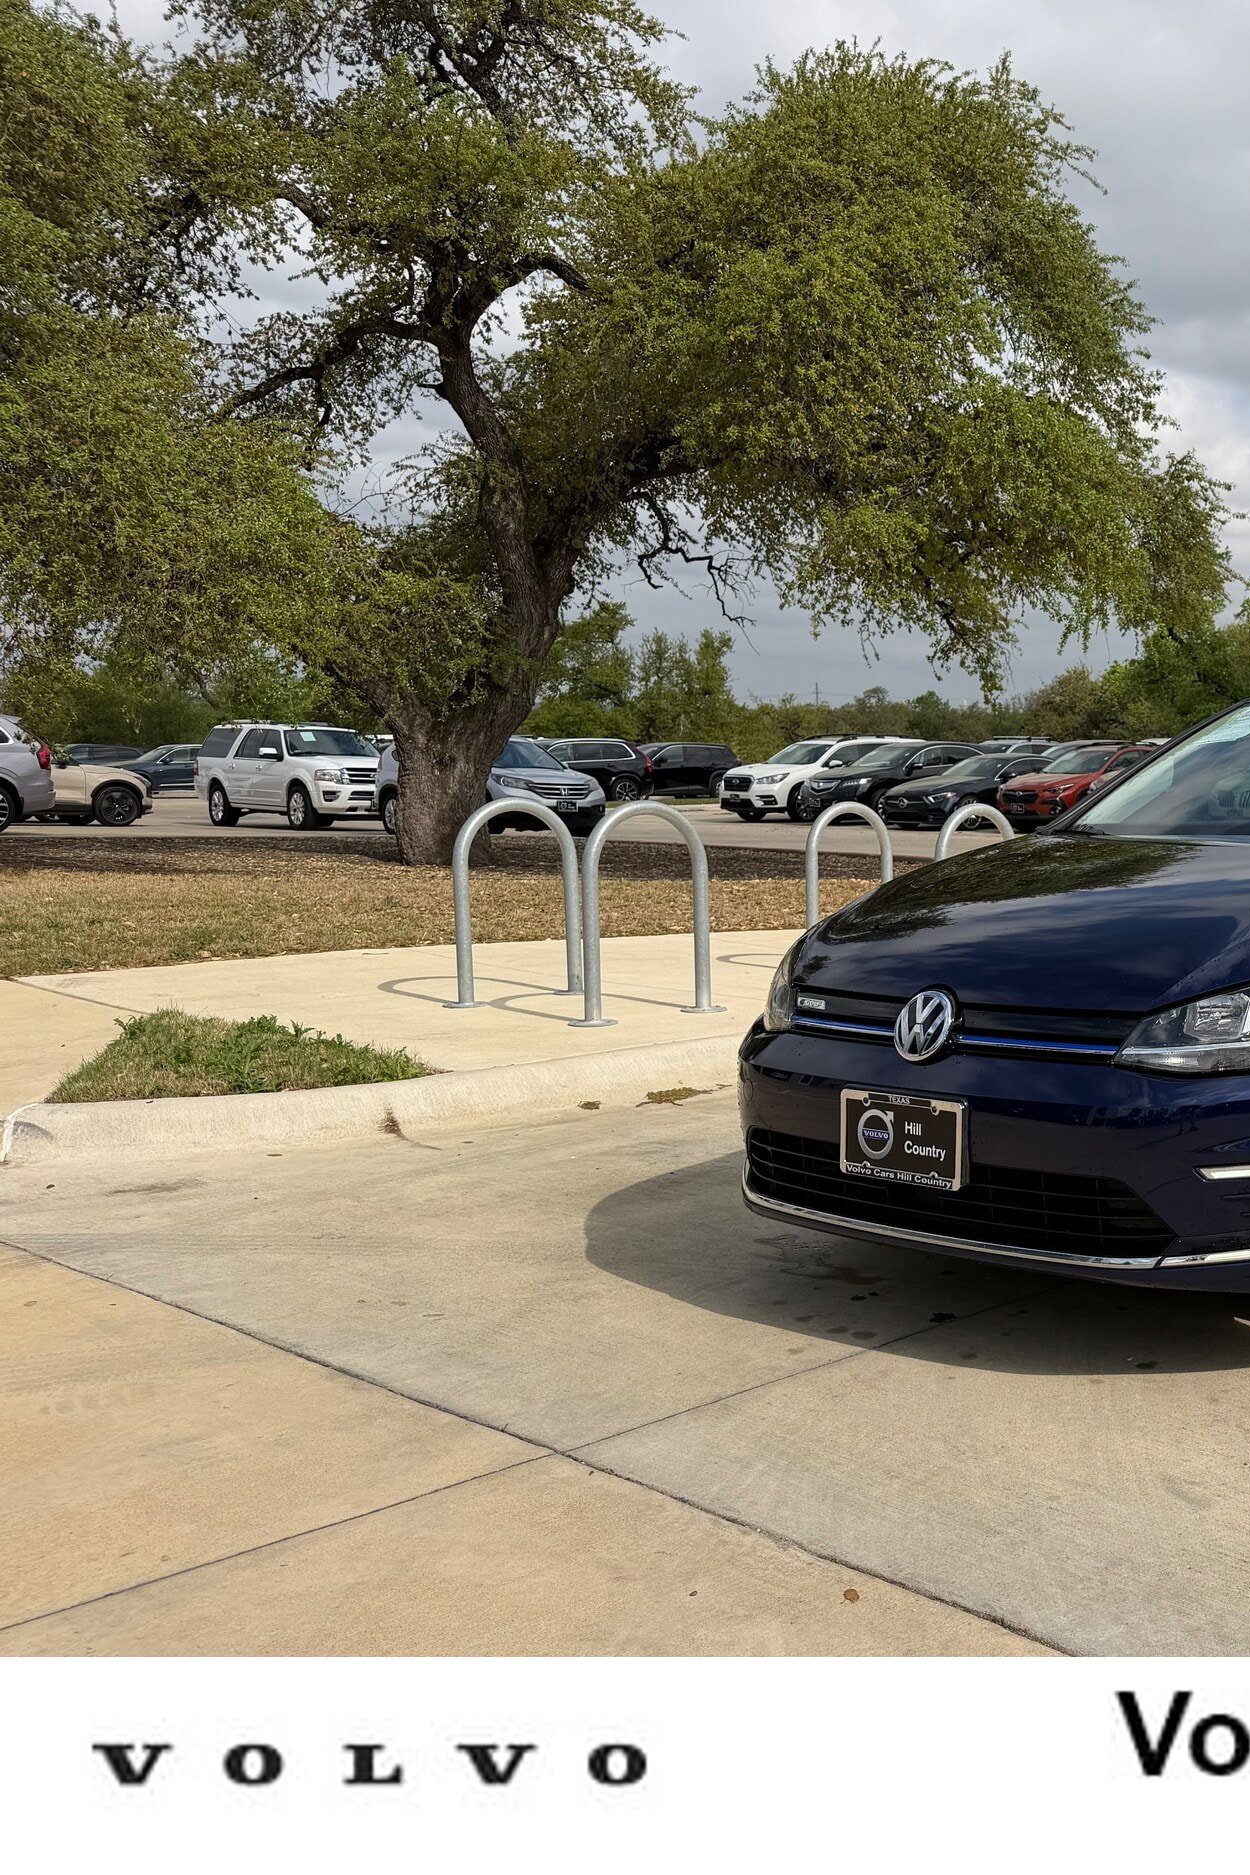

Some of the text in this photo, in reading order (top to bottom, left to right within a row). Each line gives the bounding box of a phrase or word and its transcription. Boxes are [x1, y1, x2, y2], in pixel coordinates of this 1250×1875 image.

[888, 1096, 910, 1105] TEXAS
[863, 1130, 889, 1139] VOLVO
[904, 1121, 922, 1136] Hill
[904, 1140, 946, 1161] Country
[846, 1164, 952, 1189] Volvo Cars Hill Country
